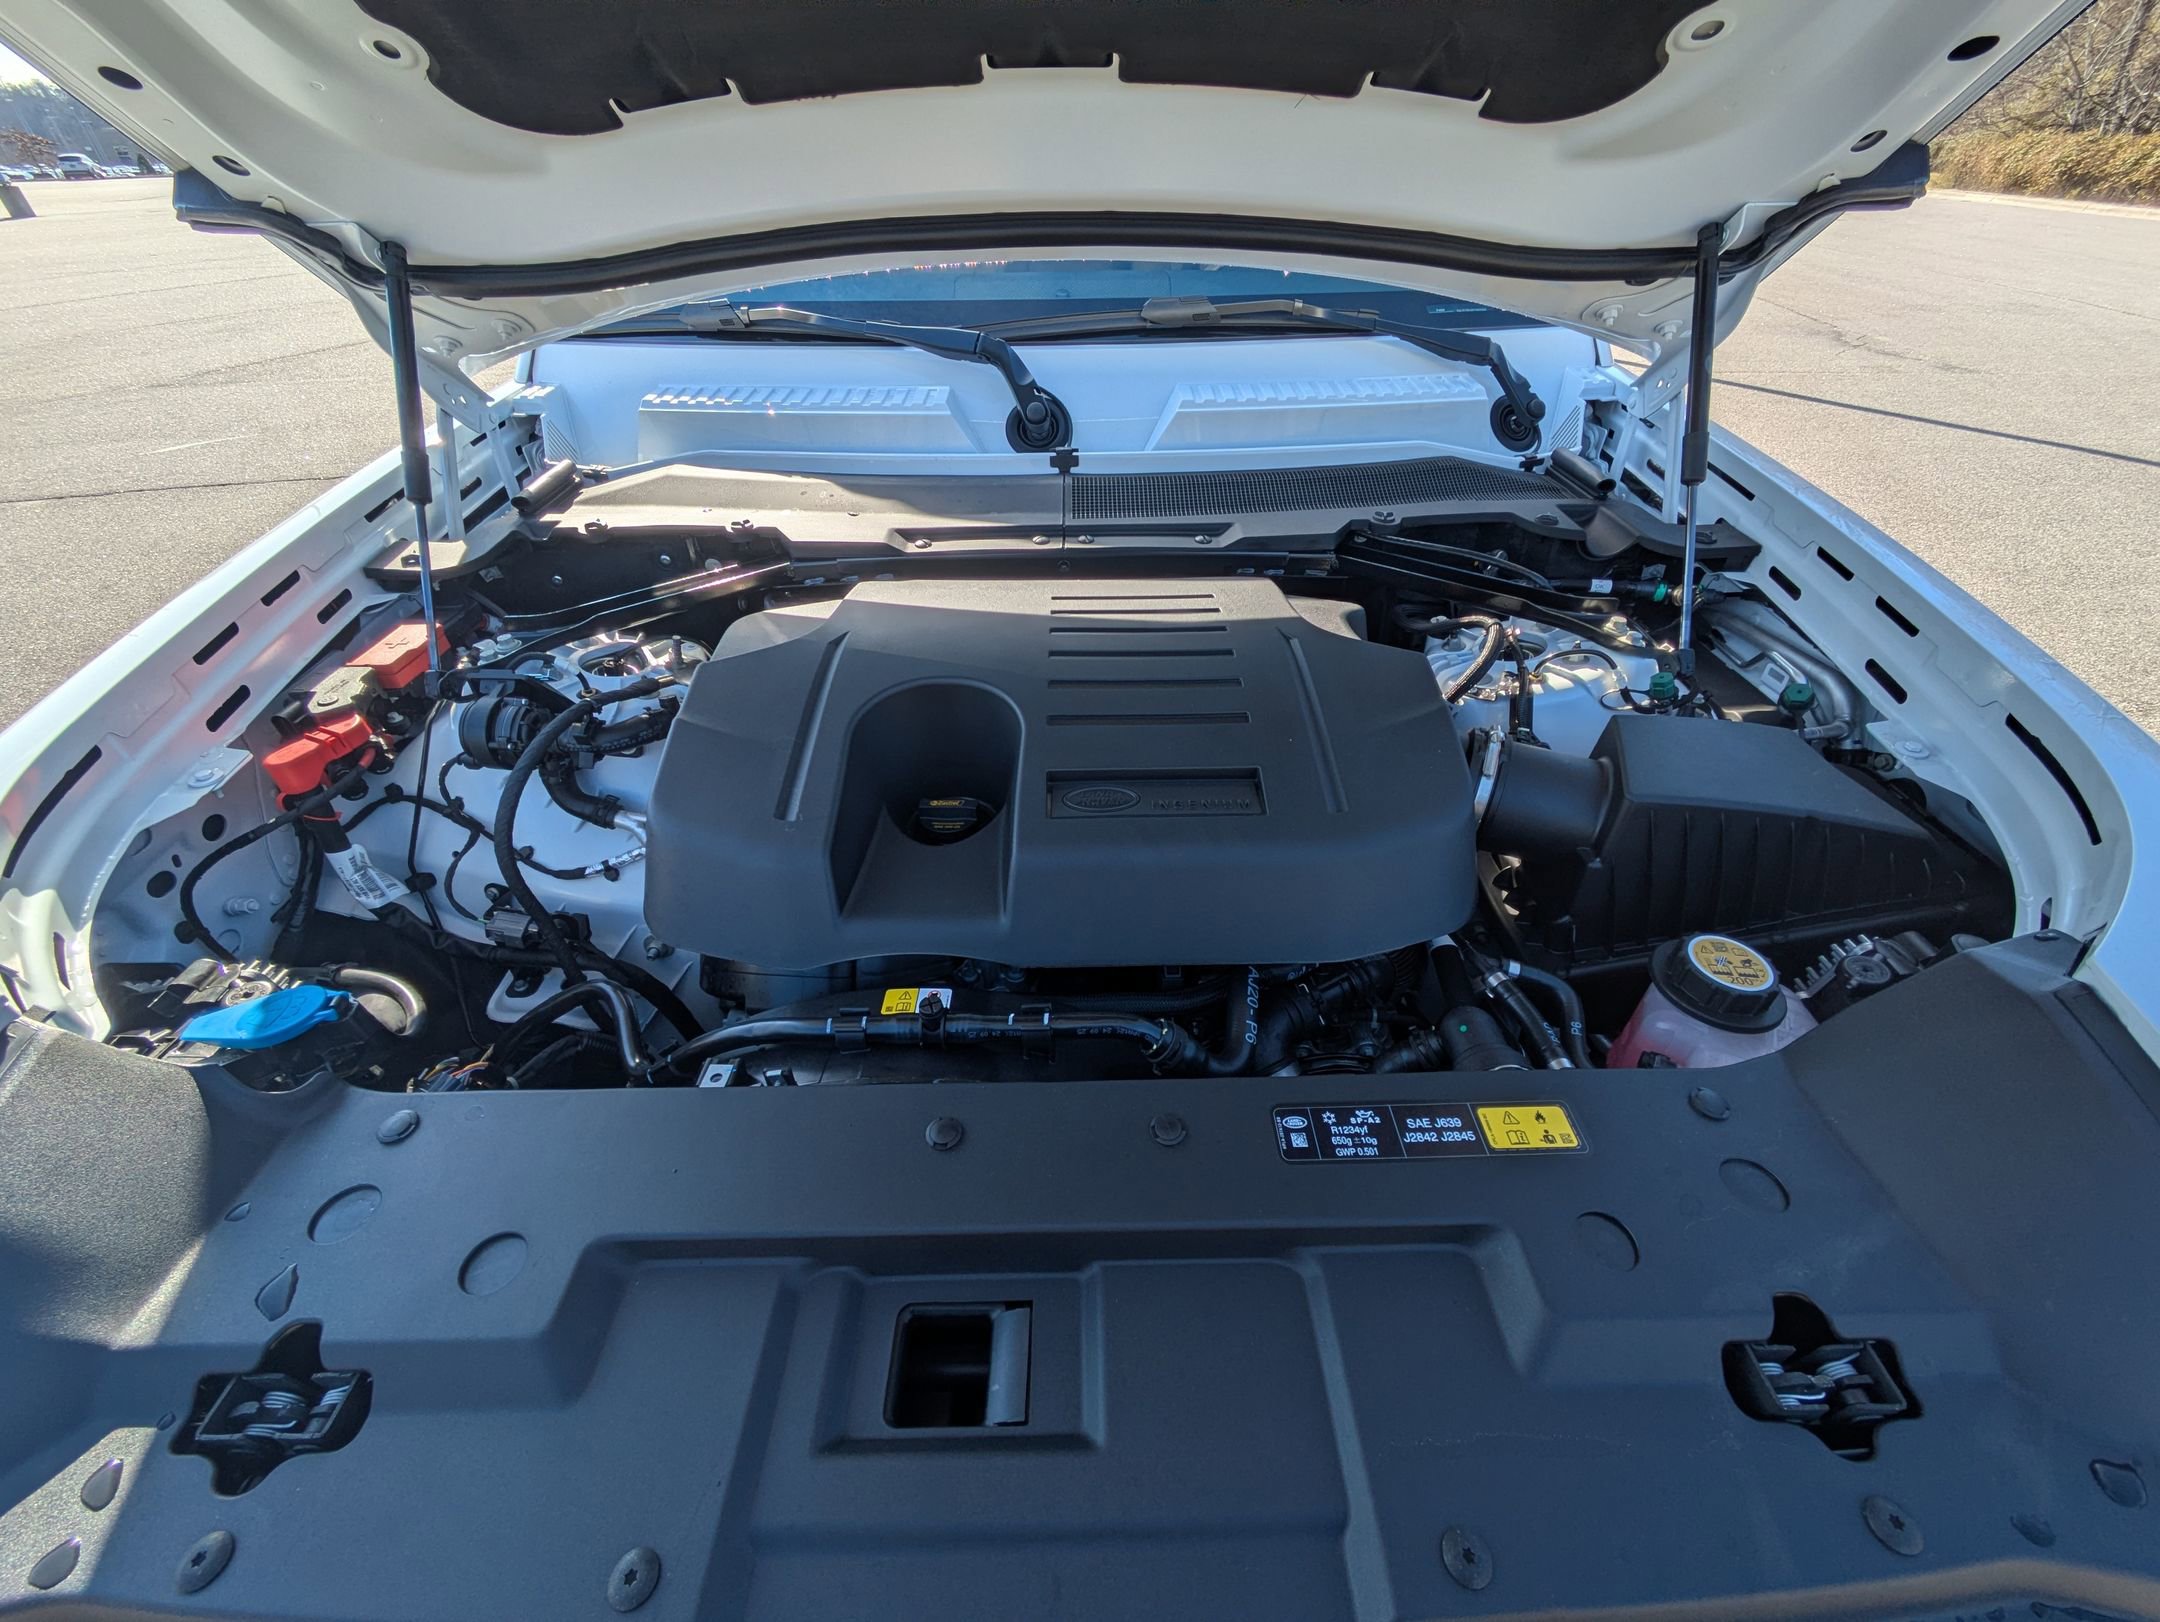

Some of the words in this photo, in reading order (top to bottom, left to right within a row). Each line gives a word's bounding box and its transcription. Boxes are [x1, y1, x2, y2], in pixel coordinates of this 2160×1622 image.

[1151, 799, 1250, 809] INGENIUM
[1245, 1019, 1258, 1046] P6
[1571, 1021, 1582, 1036] P6
[1350, 1116, 1381, 1124] SP-A2
[1406, 1118, 1432, 1128] SAE
[1434, 1117, 1462, 1127] J639
[1330, 1125, 1368, 1135] R1234yf
[1331, 1136, 1353, 1146] 650g
[1403, 1132, 1439, 1142] J2842
[1441, 1131, 1476, 1141] J2845
[1335, 1147, 1356, 1156] GWP
[1357, 1146, 1379, 1156] 0.501
